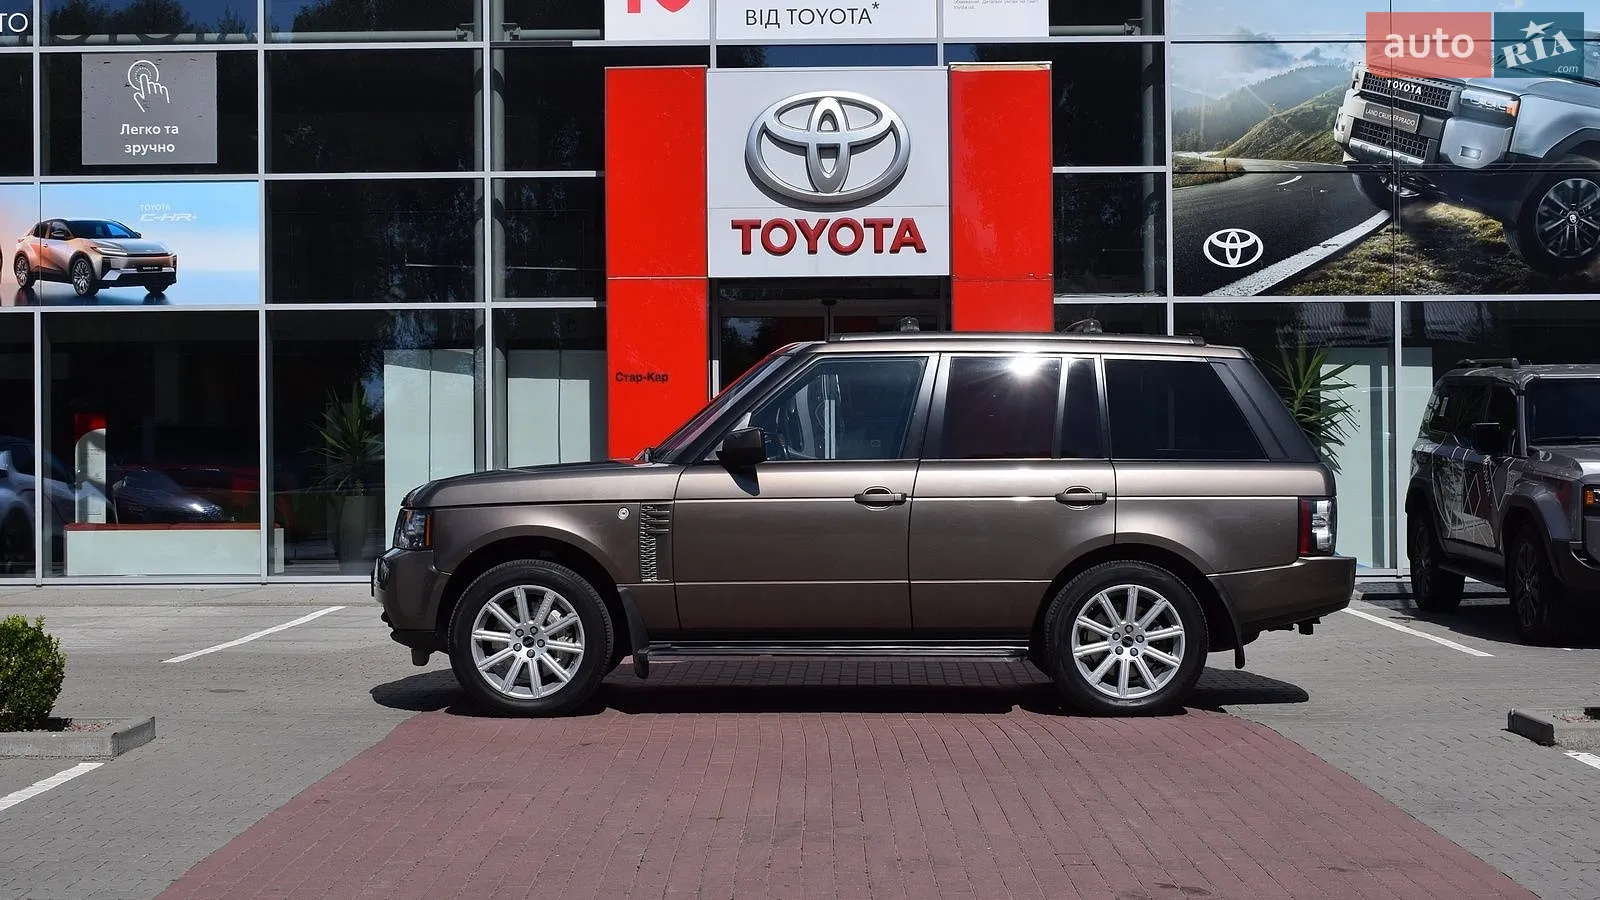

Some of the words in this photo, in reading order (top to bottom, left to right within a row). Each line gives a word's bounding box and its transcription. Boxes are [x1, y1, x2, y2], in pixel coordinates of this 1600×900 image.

[745, 9, 781, 29] ВІД
[1387, 79, 1422, 95] TOYOTA
[120, 123, 161, 135] Легко
[164, 125, 179, 135] та
[124, 143, 176, 156] зручно
[140, 203, 172, 211] TOYOTA
[731, 217, 927, 256] TOYOTA
